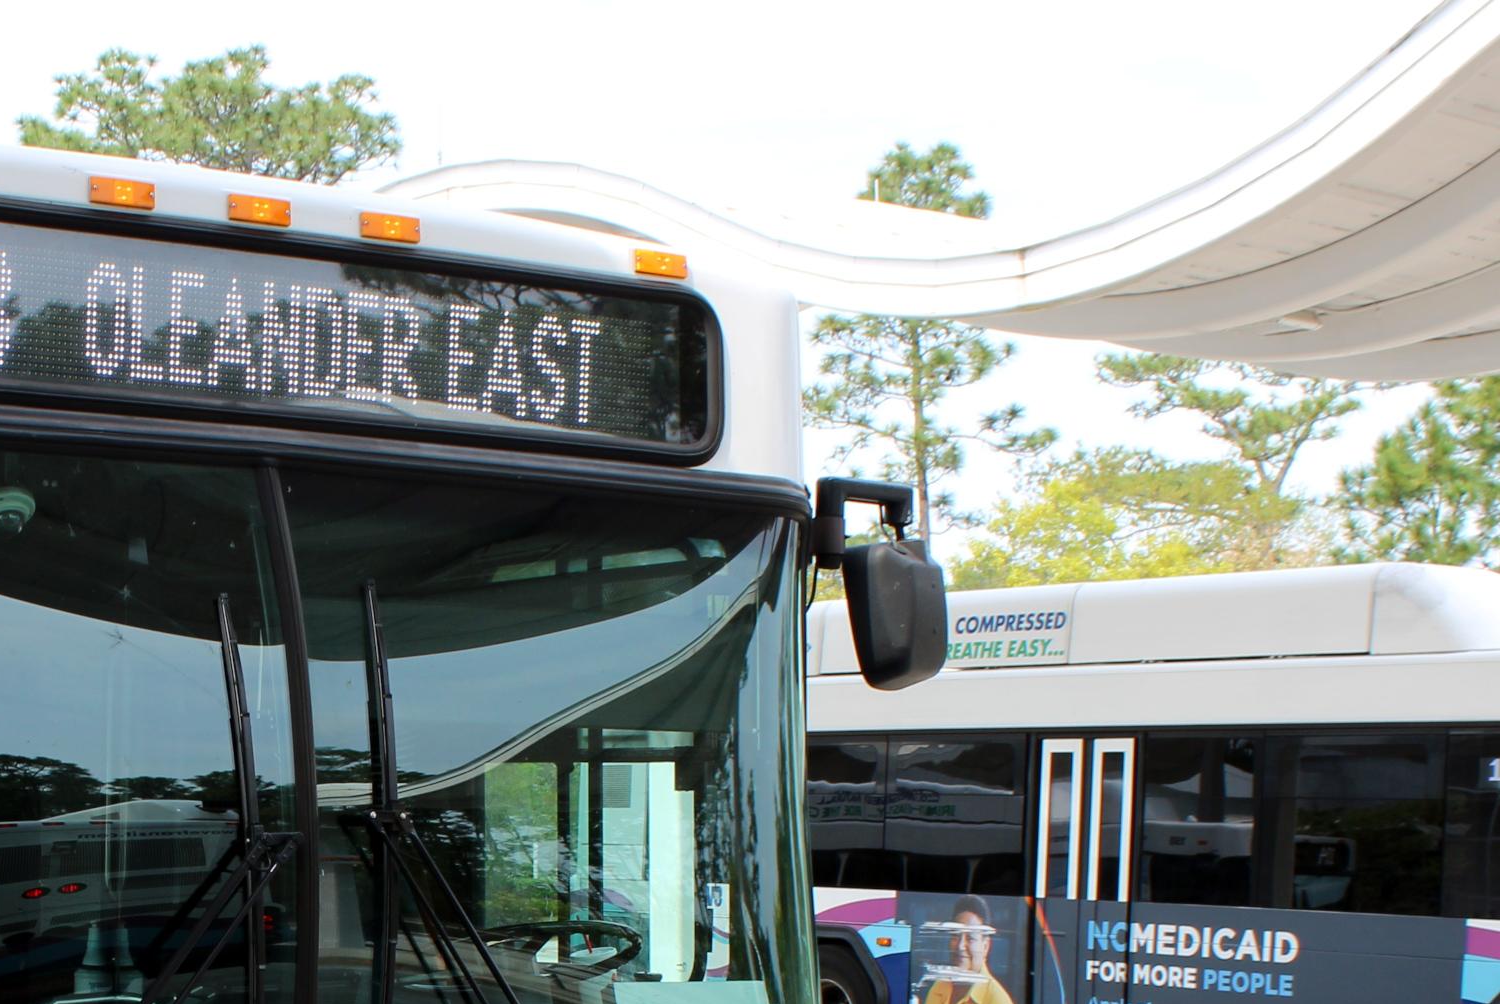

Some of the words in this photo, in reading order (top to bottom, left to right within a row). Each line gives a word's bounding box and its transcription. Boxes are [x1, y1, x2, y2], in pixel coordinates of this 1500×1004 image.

[84, 261, 420, 406] OLEANDER
[446, 302, 602, 425] EAST
[955, 611, 1067, 634] COMPRESSED
[947, 641, 1003, 660] REATHE
[1007, 639, 1065, 658] EASY...
[1085, 960, 1127, 983] FOR
[1132, 963, 1198, 989] MORE
[1203, 968, 1295, 997] PEOPLE
